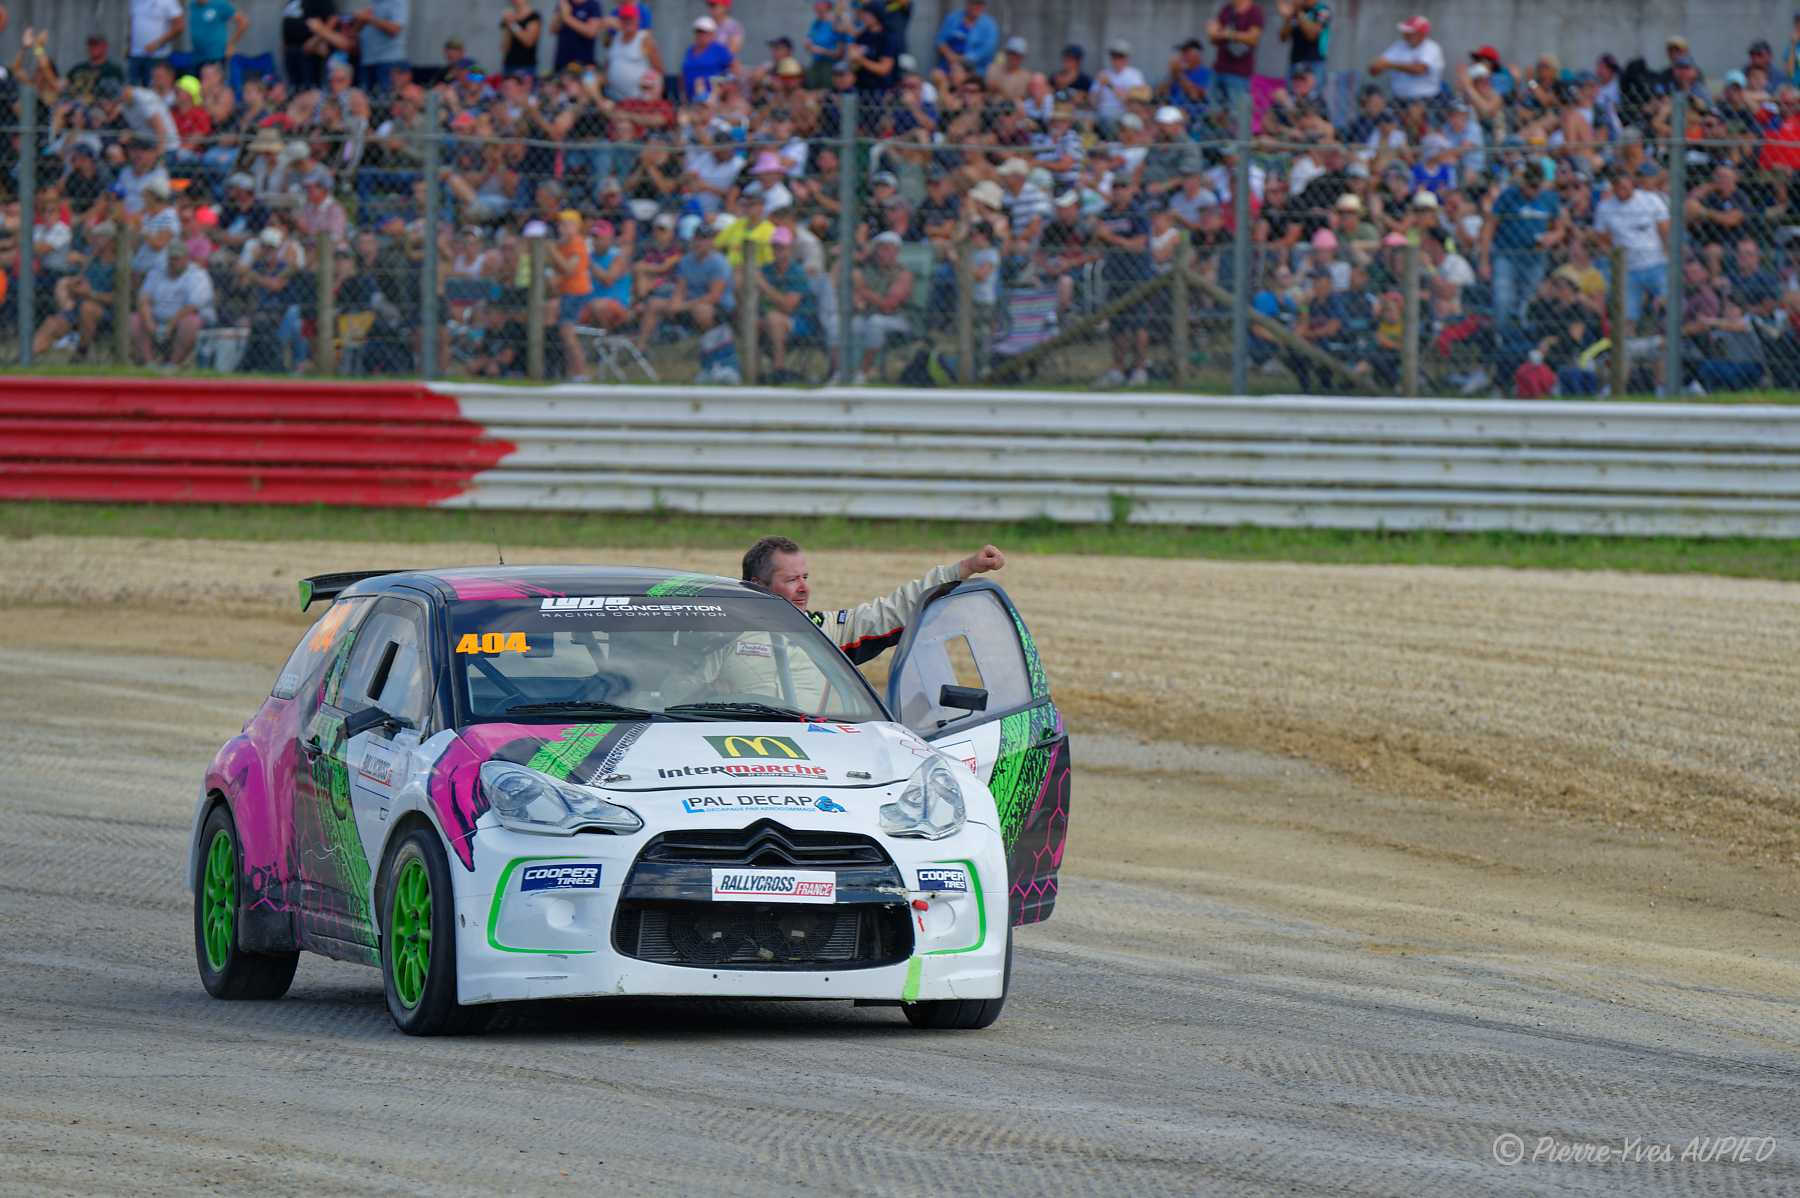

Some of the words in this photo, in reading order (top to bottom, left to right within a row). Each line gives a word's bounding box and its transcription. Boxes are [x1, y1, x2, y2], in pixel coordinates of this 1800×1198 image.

[455, 632, 531, 655] 404
[688, 797, 732, 807] PAL
[737, 795, 813, 806] DECAP
[525, 868, 598, 880] COOPER
[919, 871, 964, 881] COOPER
[557, 877, 595, 885] TIRES
[721, 875, 795, 892] RALLYCROSS
[799, 883, 832, 896] FRANCE
[944, 881, 966, 889] TIRES
